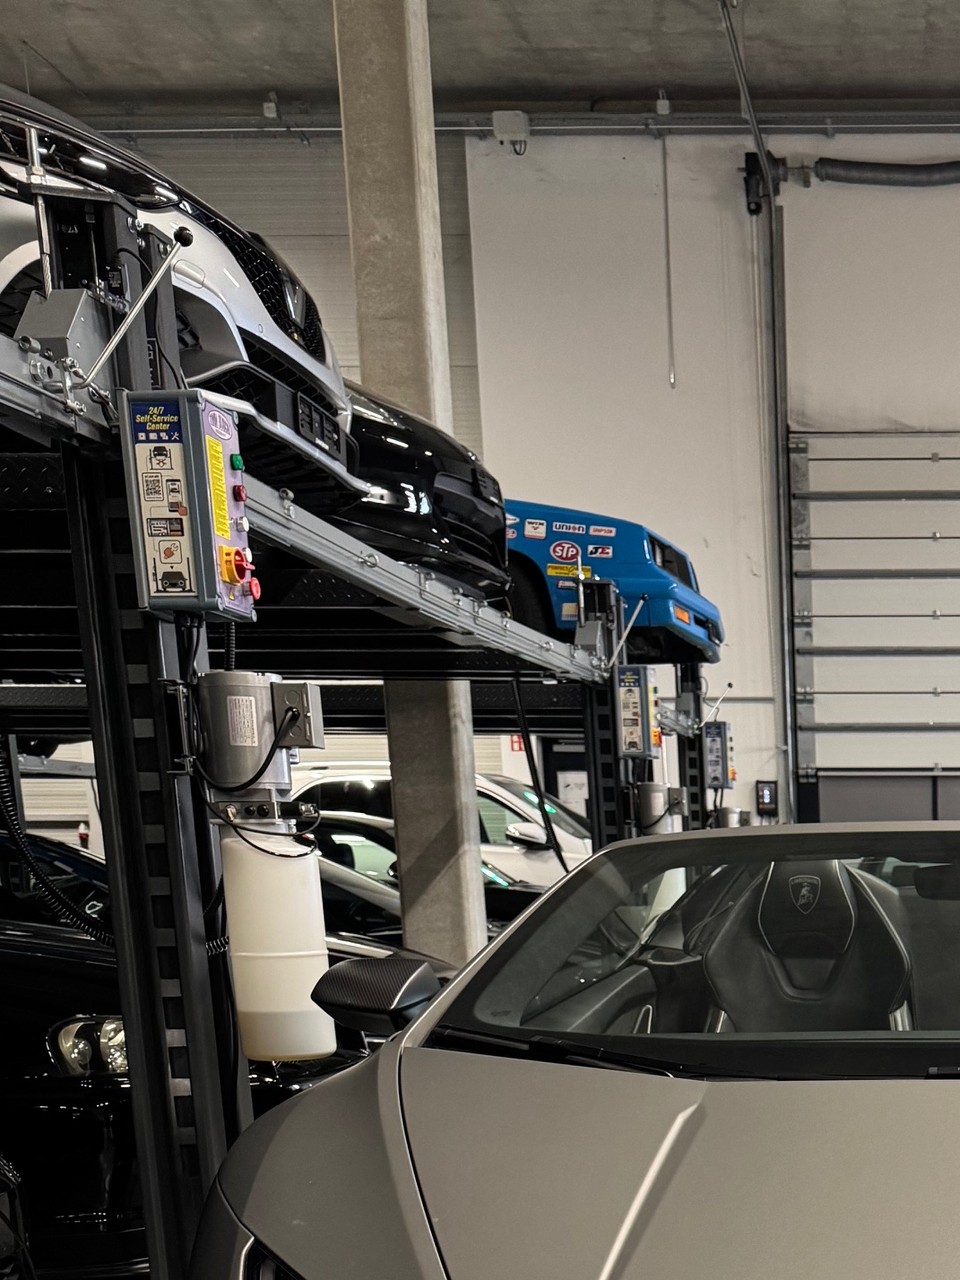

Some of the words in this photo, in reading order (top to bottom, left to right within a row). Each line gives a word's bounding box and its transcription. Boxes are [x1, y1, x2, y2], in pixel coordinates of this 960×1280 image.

[149, 406, 165, 414] 24/7
[135, 414, 179, 423] Self-Service
[555, 543, 577, 558] STP
[589, 547, 611, 555] JE
